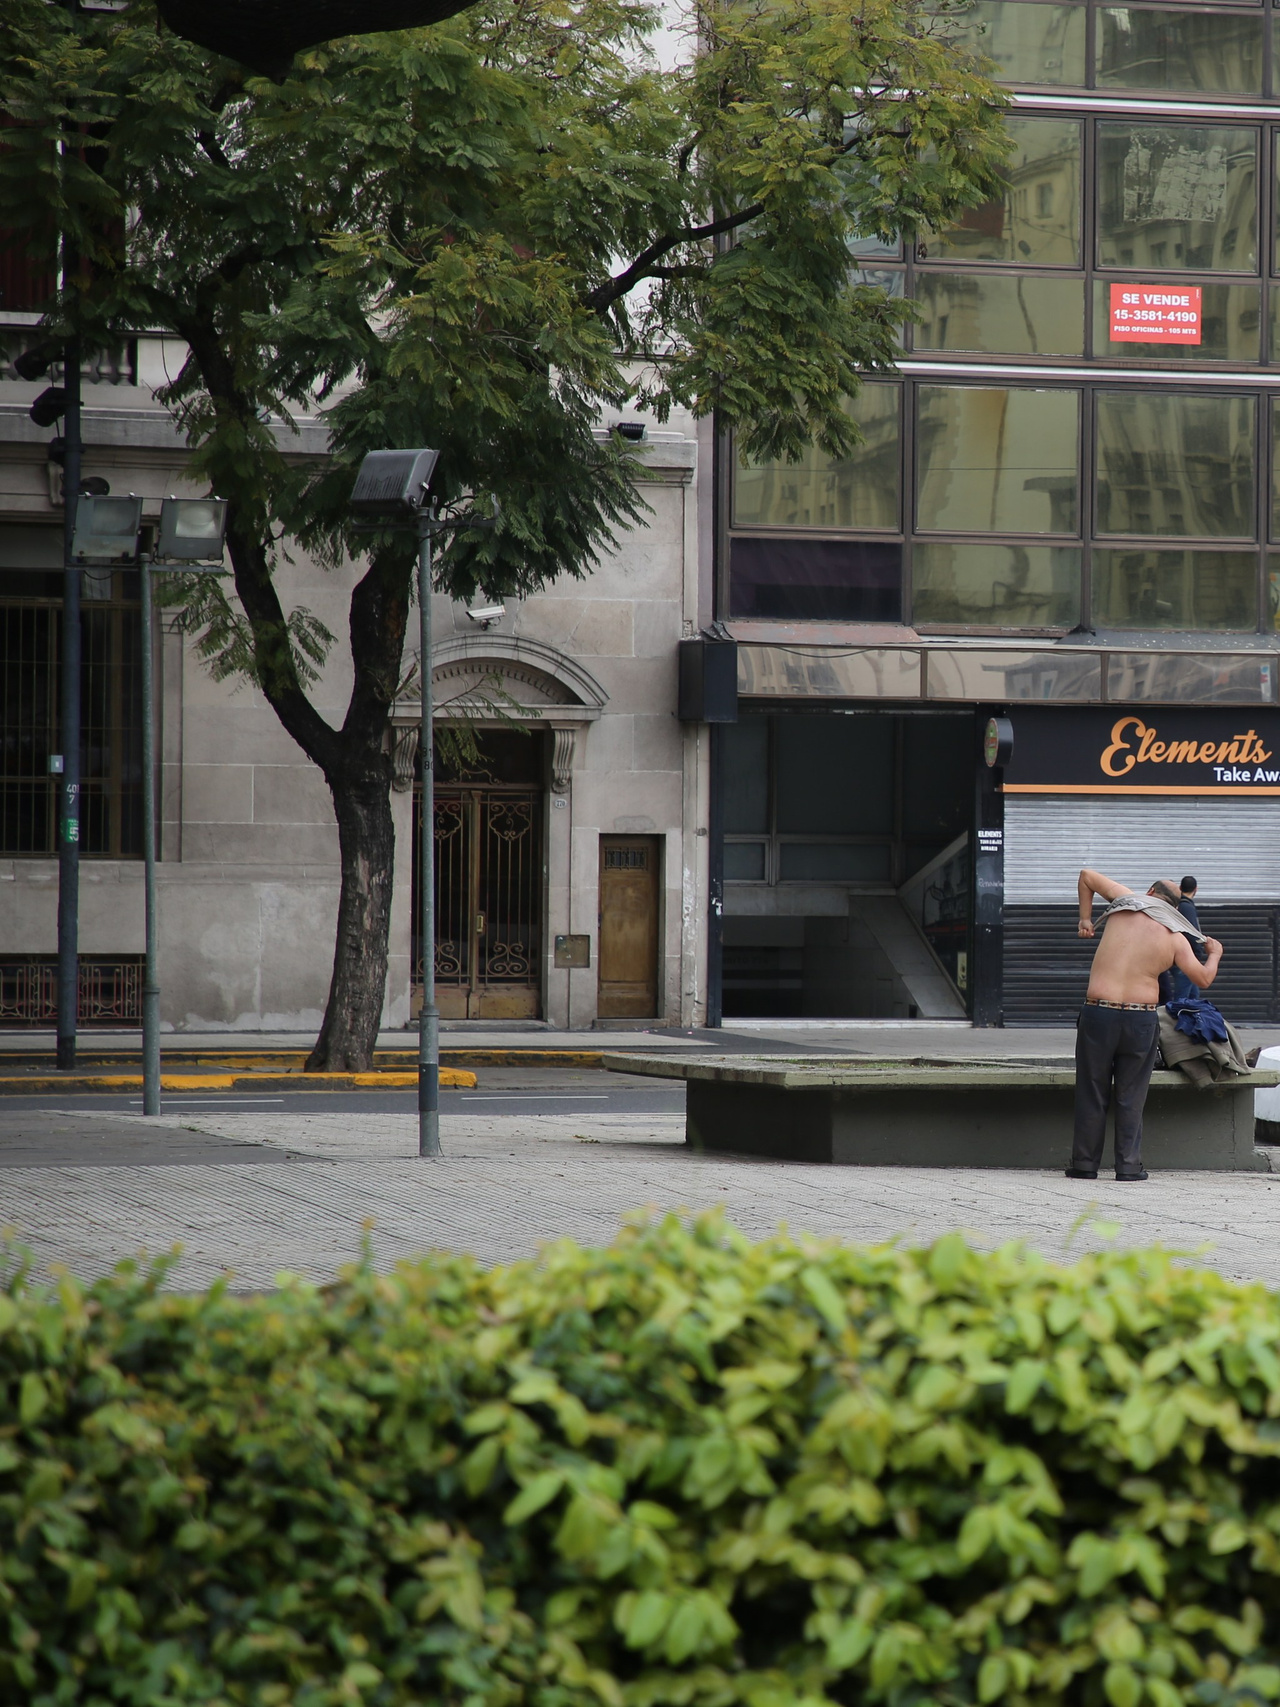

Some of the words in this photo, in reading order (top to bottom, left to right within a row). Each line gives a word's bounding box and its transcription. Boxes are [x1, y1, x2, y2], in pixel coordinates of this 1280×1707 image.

[1122, 293, 1140, 304] SE
[1143, 294, 1189, 306] VENDE
[1114, 309, 1197, 323] 15-3581-4190
[1100, 716, 1272, 777] Elements
[1213, 767, 1251, 782] Take
